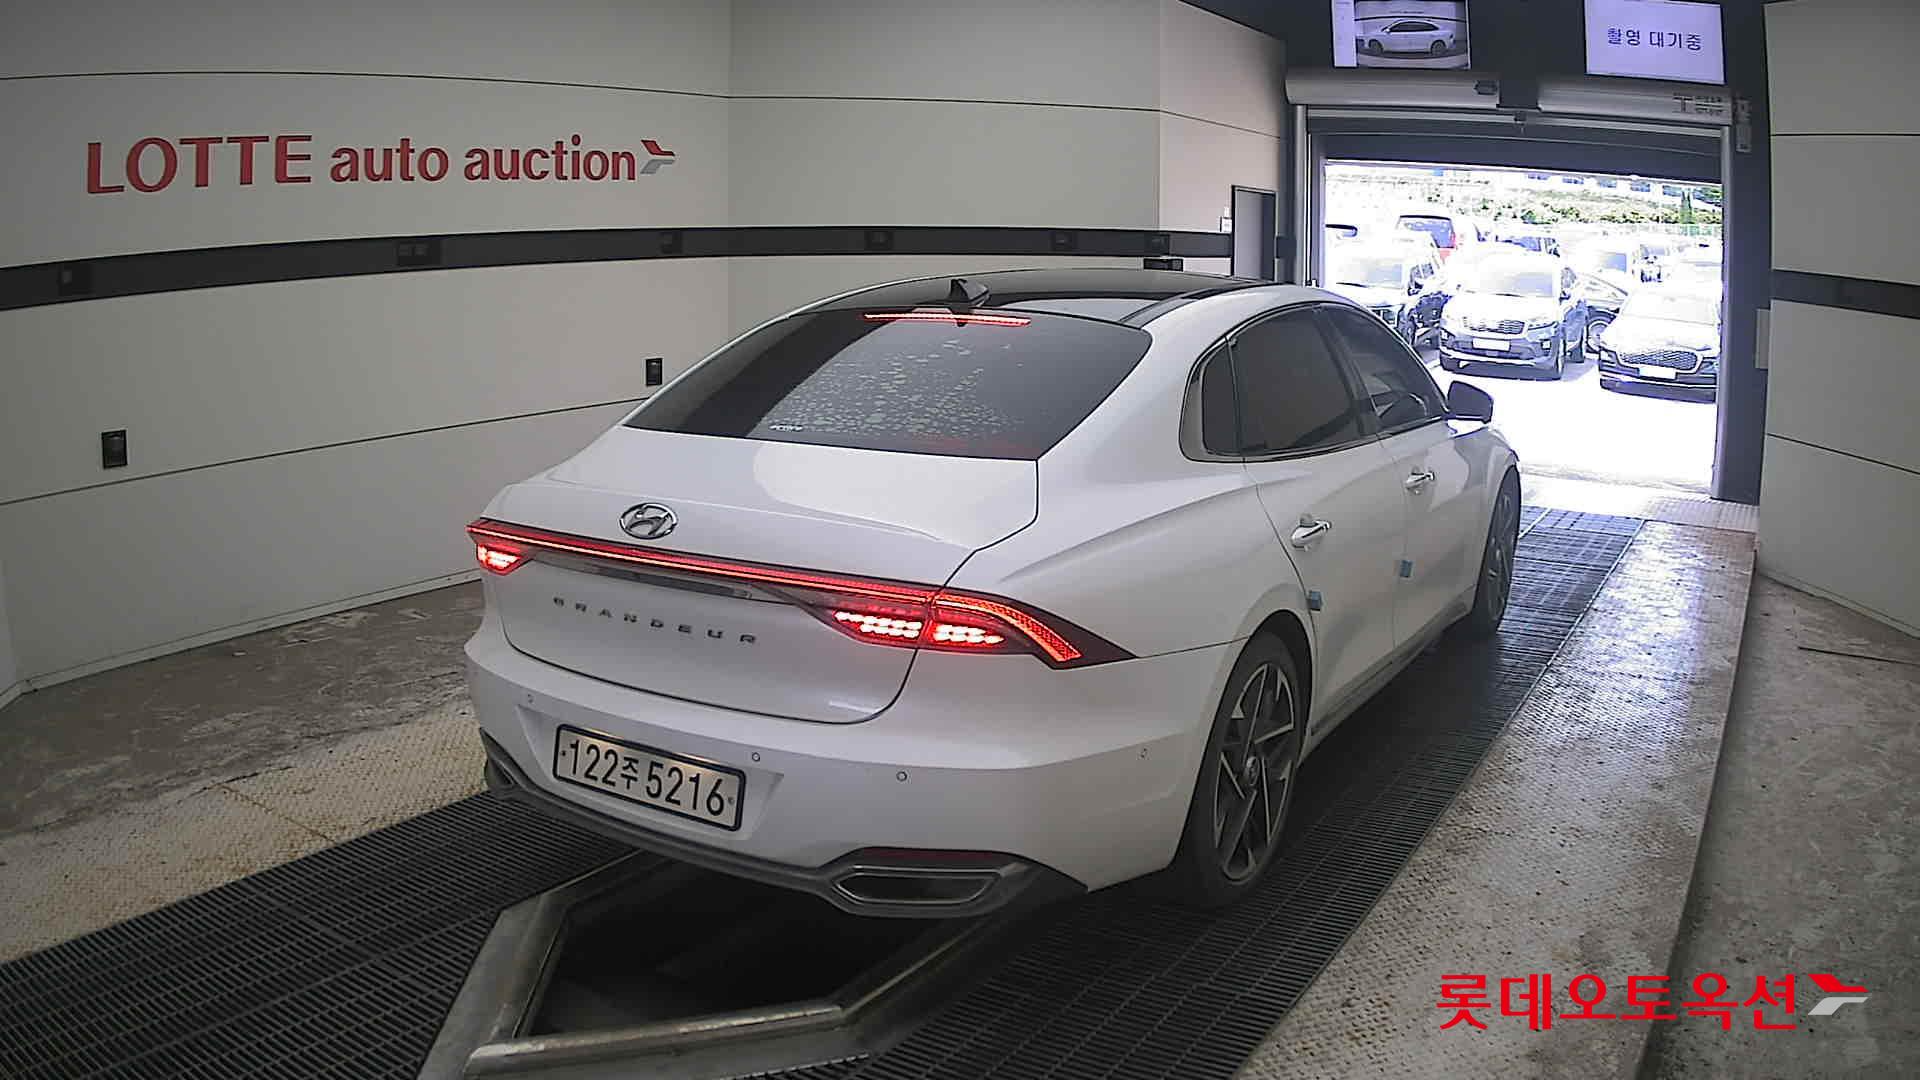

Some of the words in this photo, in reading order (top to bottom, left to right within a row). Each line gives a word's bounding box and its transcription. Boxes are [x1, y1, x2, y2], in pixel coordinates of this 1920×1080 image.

[1608, 28, 1641, 46] 촬영
[1649, 31, 1701, 51] 대기중
[88, 135, 312, 194] LOTTE
[330, 138, 449, 182] auto
[464, 134, 637, 182] auction
[553, 597, 757, 644] GRANDEUR
